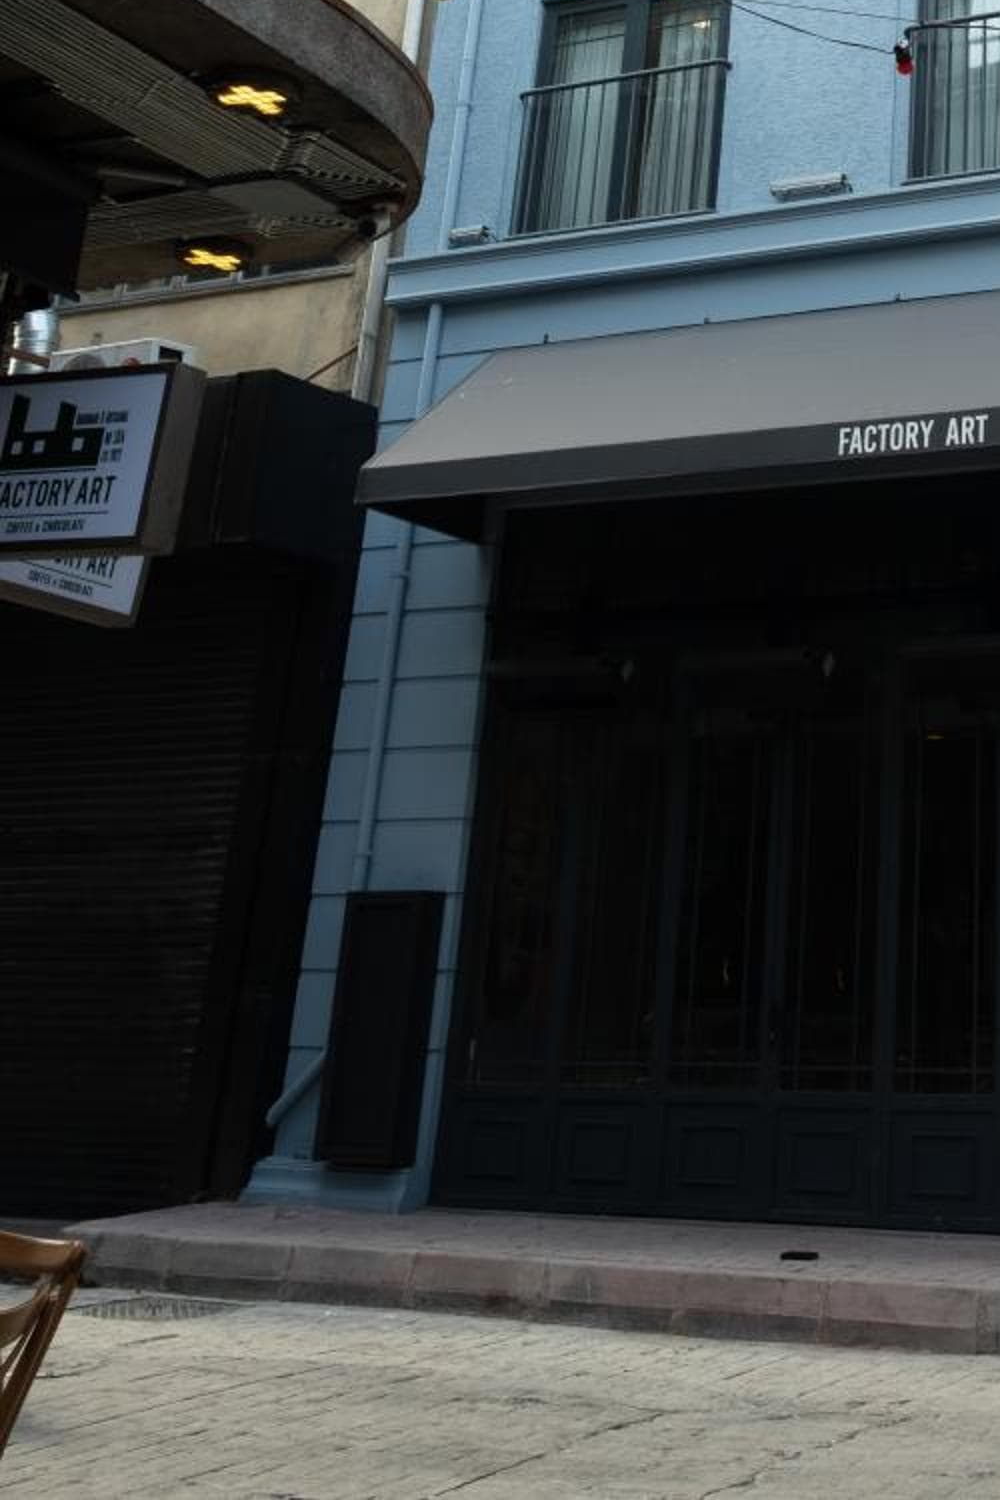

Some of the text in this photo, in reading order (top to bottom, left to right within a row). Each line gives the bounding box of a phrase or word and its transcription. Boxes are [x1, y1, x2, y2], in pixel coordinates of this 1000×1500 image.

[838, 414, 988, 456] FACTORY ART
[75, 475, 117, 505] ART
